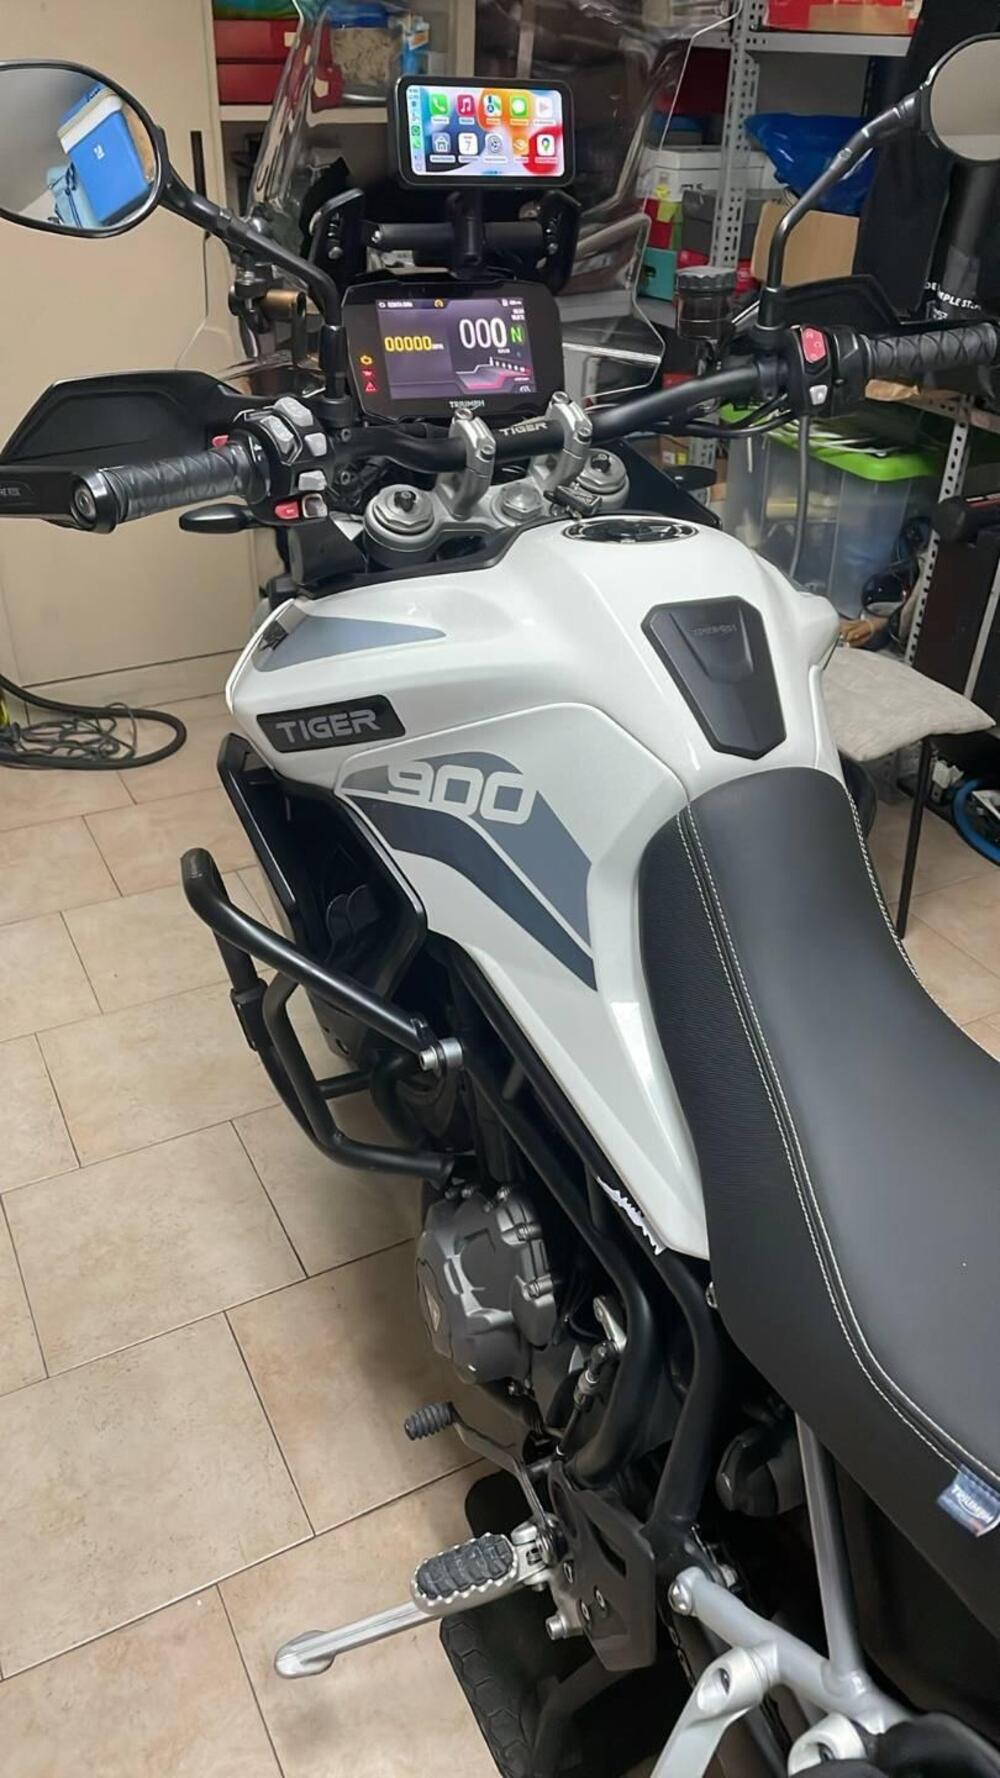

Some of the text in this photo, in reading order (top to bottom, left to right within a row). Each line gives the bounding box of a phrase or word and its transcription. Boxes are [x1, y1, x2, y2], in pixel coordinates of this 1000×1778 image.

[384, 335, 432, 352] 00000
[459, 317, 524, 349] 000 N
[498, 422, 548, 437] TIGER
[275, 709, 381, 744] TIGER
[387, 761, 537, 825] 900
